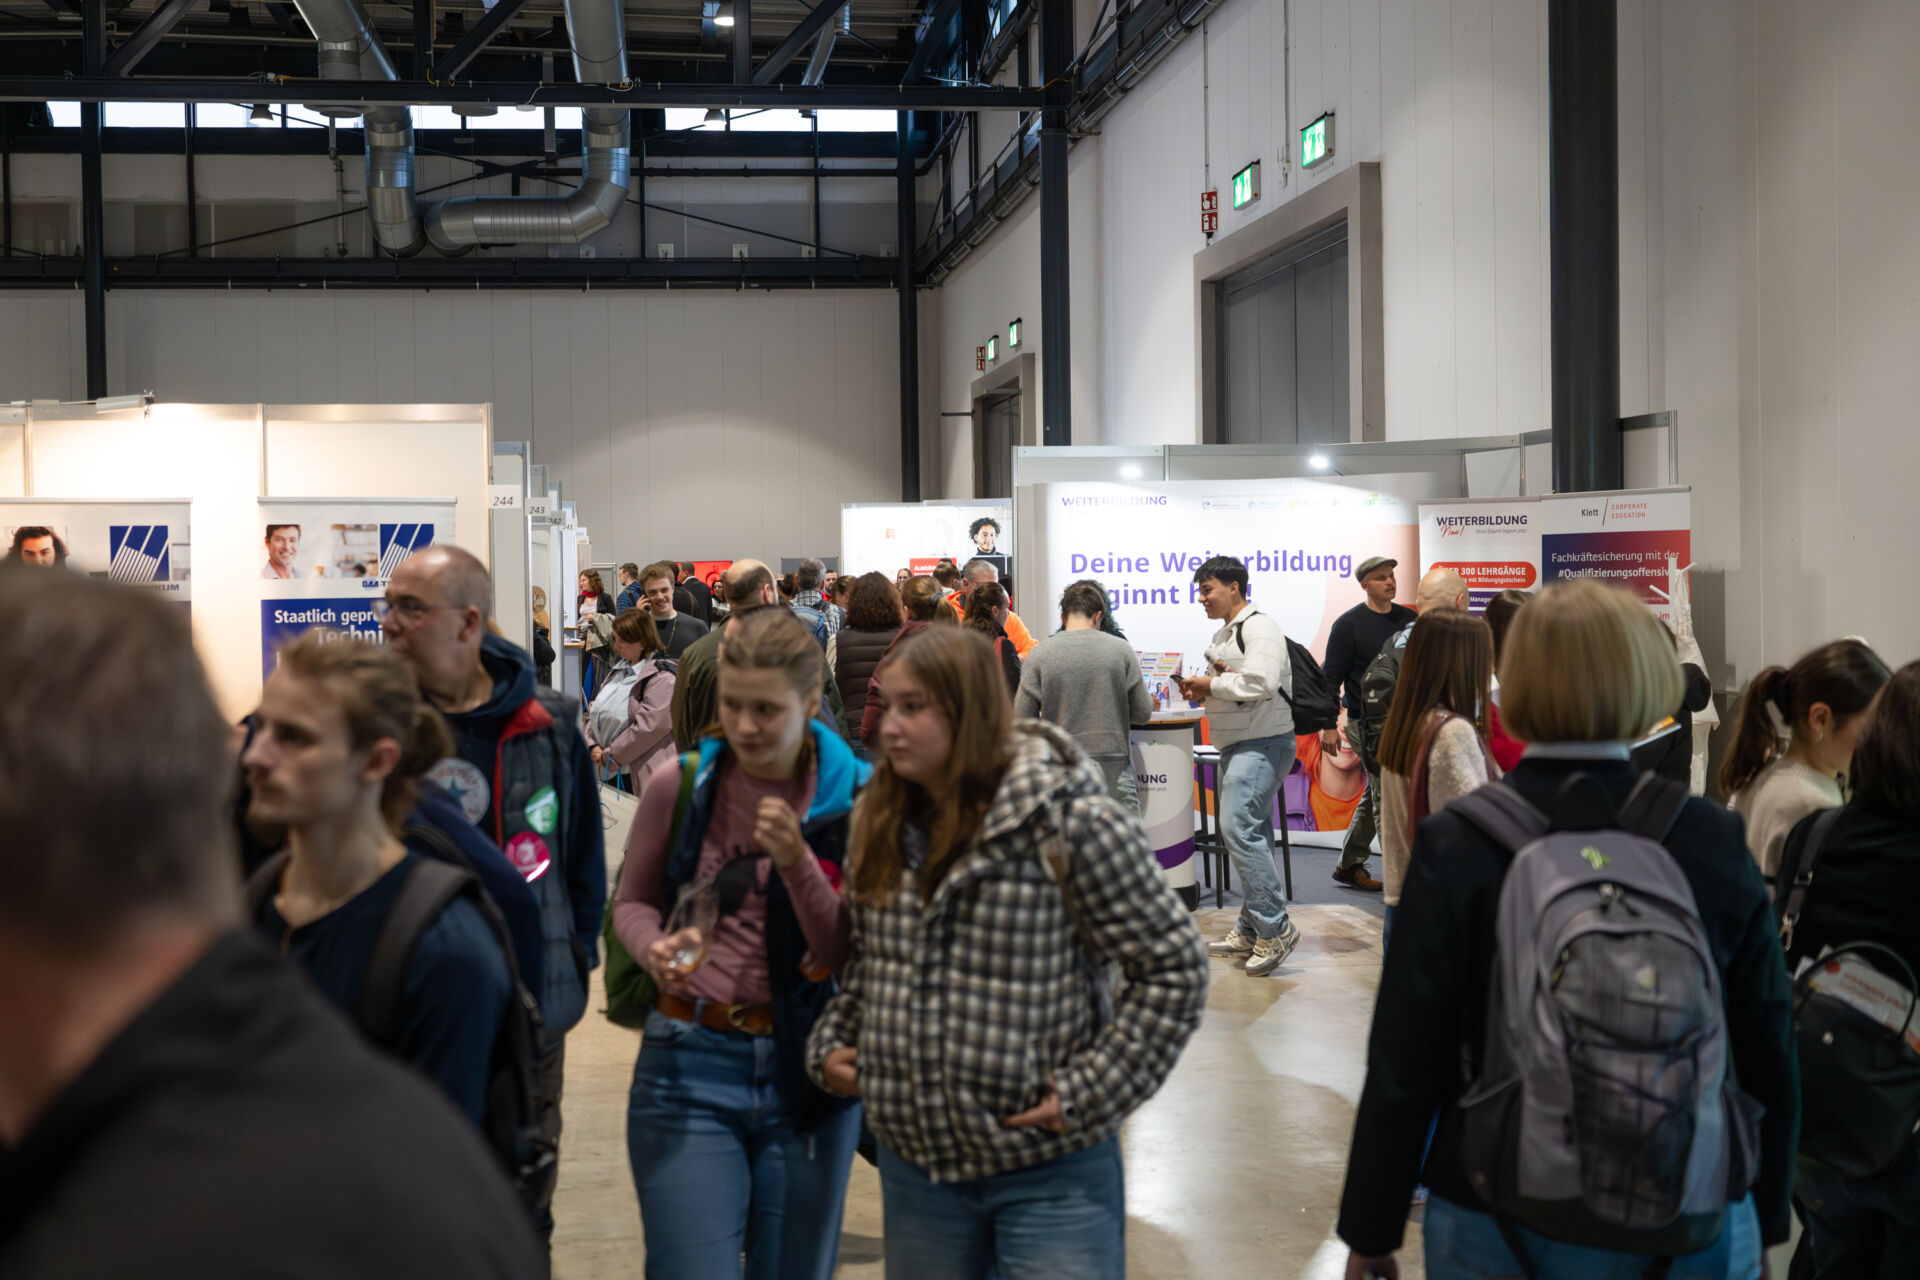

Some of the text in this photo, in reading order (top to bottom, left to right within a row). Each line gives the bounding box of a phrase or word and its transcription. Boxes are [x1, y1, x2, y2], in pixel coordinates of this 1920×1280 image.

[492, 496, 514, 506] 244
[1611, 502, 1647, 510] CORPORATE
[529, 505, 546, 515] 243
[1581, 508, 1599, 517] Klett
[1611, 511, 1646, 519] EDUCATION
[1436, 515, 1528, 526] WEITERBILDUNG
[1440, 524, 1465, 538] Now!
[1551, 550, 1680, 564] Fachkräftesicherung mit der
[1071, 550, 1352, 578] Deine Werbildung
[1461, 567, 1475, 576] 300
[1477, 565, 1527, 576] LEHRGÄNGE
[1558, 566, 1669, 581] #Qualifizierungsoffensiv
[1107, 586, 1180, 611] ginnt
[274, 608, 336, 624] Staatlich
